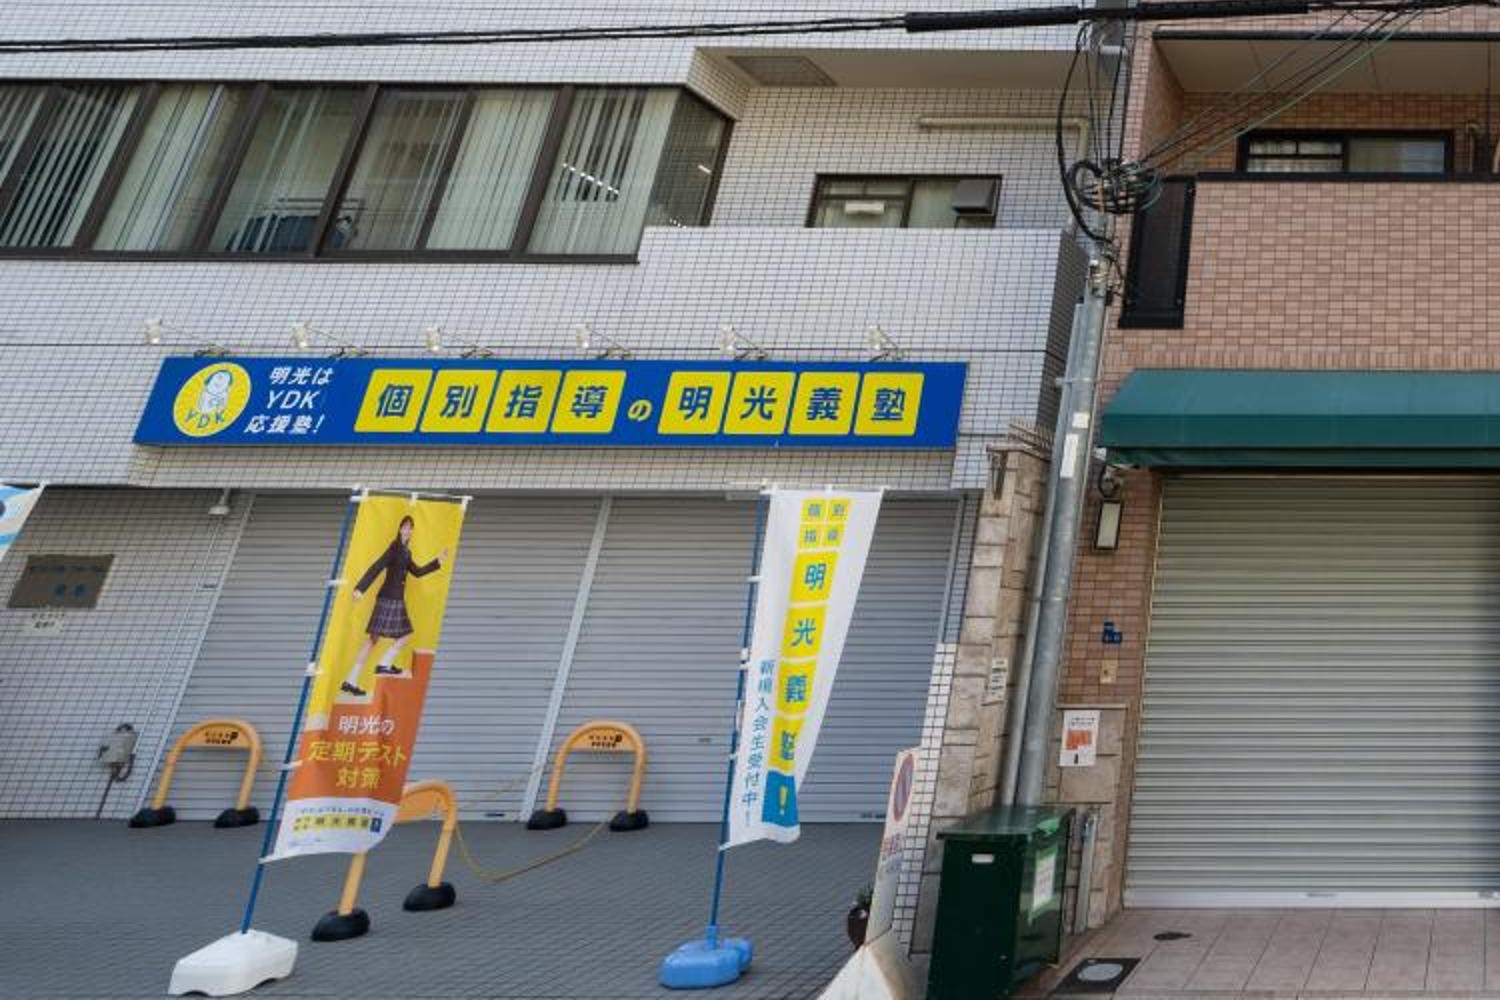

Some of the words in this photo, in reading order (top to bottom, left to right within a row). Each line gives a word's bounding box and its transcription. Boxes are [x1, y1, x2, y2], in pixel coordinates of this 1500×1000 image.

[270, 366, 334, 385] 明光は
[266, 389, 320, 409] YDK
[375, 384, 905, 423] 個別指導の明光義塾
[186, 408, 225, 429] YDK
[338, 712, 395, 735] 明光の
[308, 741, 407, 768] 定期テスト
[336, 767, 381, 790] 対策
